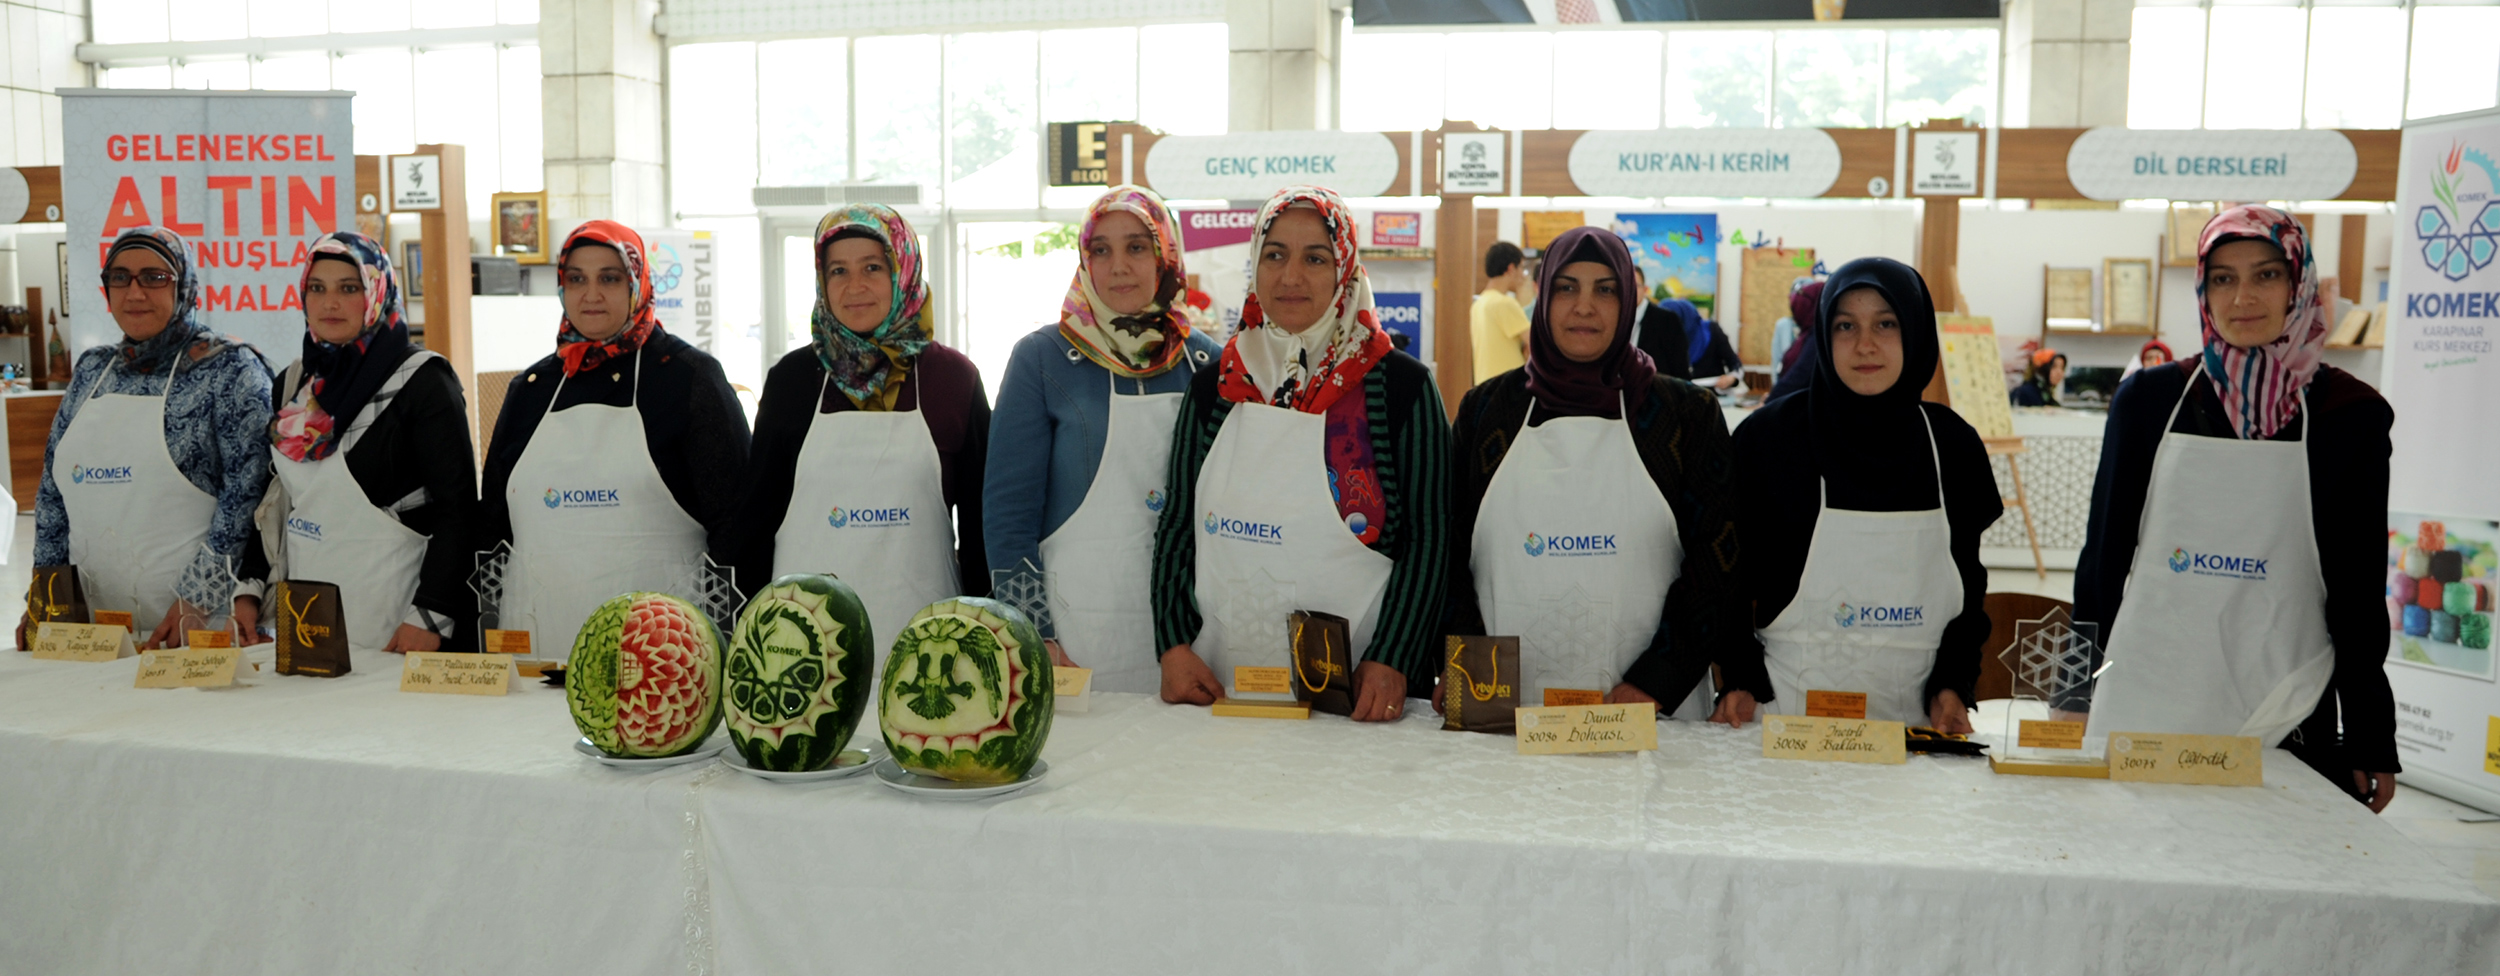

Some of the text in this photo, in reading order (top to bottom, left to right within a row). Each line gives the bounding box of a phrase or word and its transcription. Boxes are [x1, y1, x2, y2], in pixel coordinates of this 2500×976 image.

[106, 134, 335, 162] GELENEKSEL
[1077, 123, 1106, 169] E
[1205, 154, 1337, 179] GENÇ KOMEK
[1722, 149, 1790, 172] KERİM
[2133, 151, 2288, 175] DİL DERSLERİ
[2457, 191, 2487, 202] KOMEK
[101, 176, 337, 237] ALTIN
[2406, 292, 2500, 318] KOMEK
[2422, 325, 2485, 338] KARAPINAR
[86, 467, 132, 479] KOMEK
[563, 489, 619, 502] KOMEK
[850, 508, 910, 522] KOMEK
[288, 517, 322, 536] KOMEK
[1221, 517, 1282, 539] KOMEK
[1548, 535, 1617, 550] KOMEK
[2194, 553, 2268, 574] KOMEK
[1860, 606, 1923, 621] KOMEK
[766, 645, 803, 657] KOMEK
[1583, 709, 1626, 725] Damat
